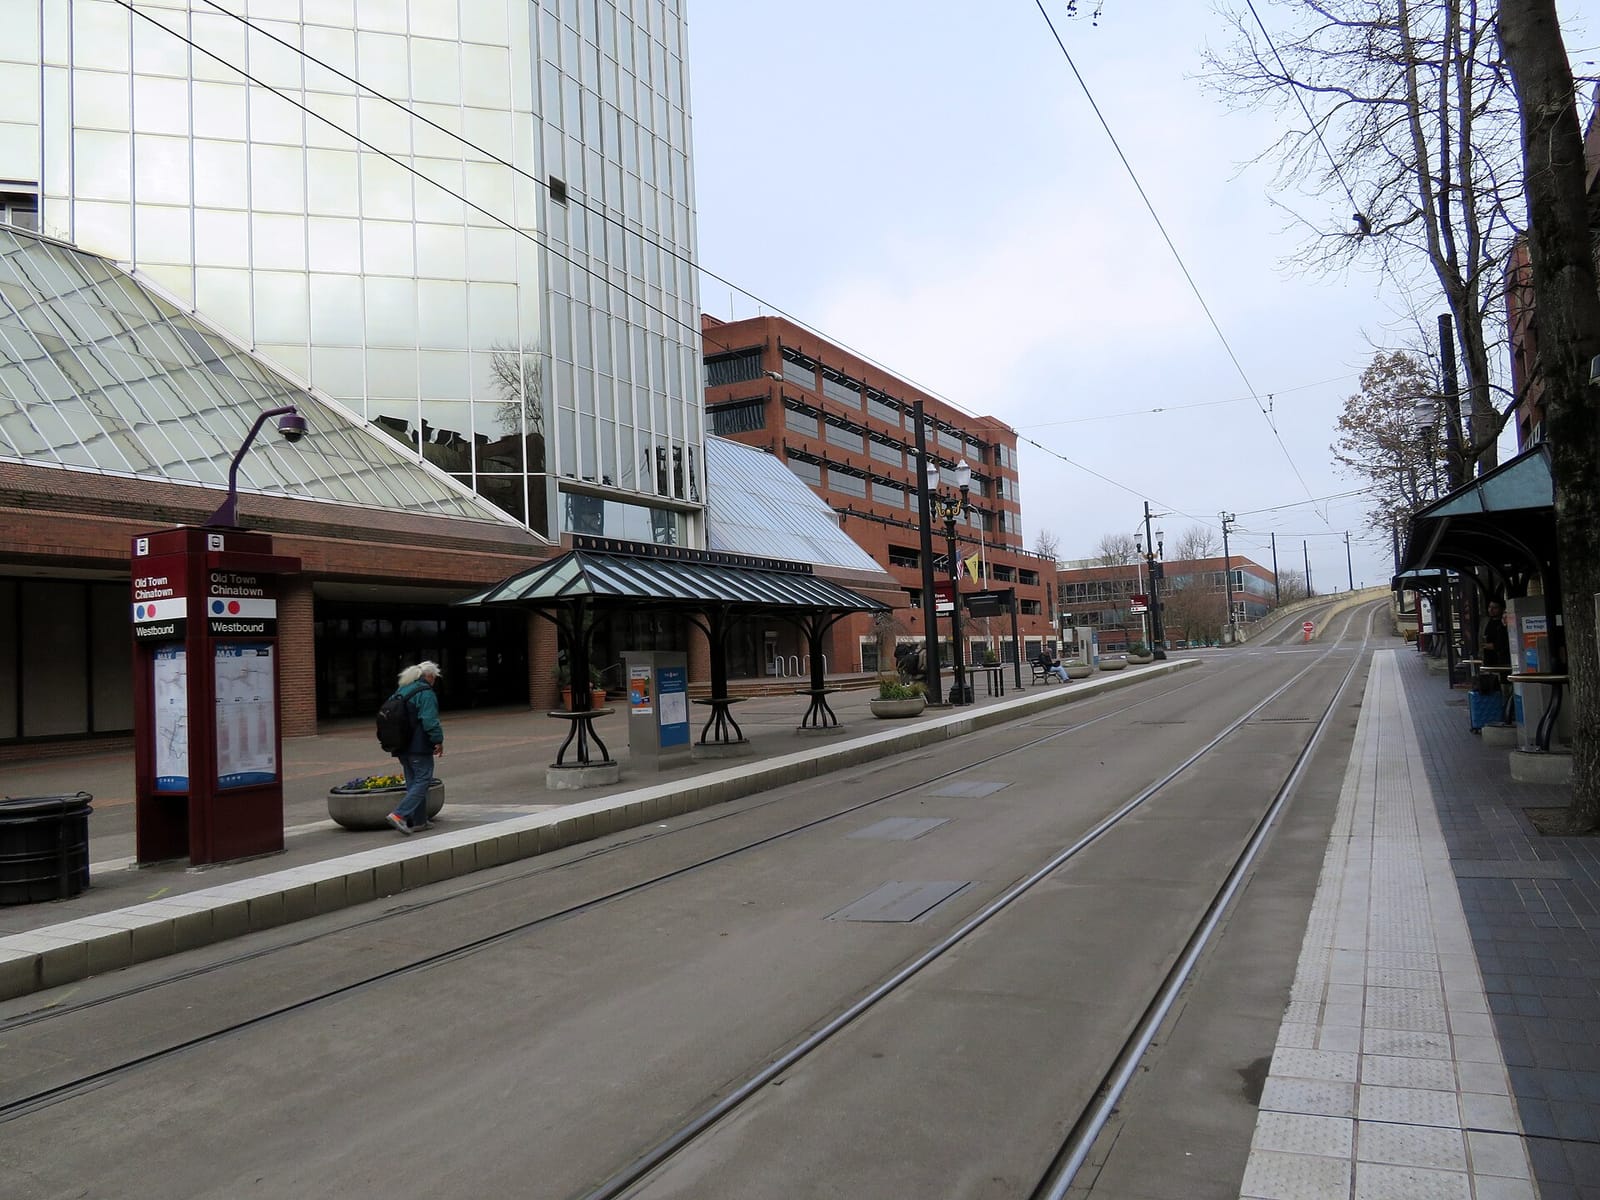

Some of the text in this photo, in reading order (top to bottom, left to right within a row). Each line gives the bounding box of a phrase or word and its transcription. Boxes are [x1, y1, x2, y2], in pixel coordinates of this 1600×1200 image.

[134, 576, 168, 588] Old Town
[211, 572, 257, 584] Old Town
[134, 587, 173, 600] Chinatown
[211, 584, 264, 596] Chinatown
[136, 623, 175, 637] Westbound
[211, 622, 264, 633] Westbound
